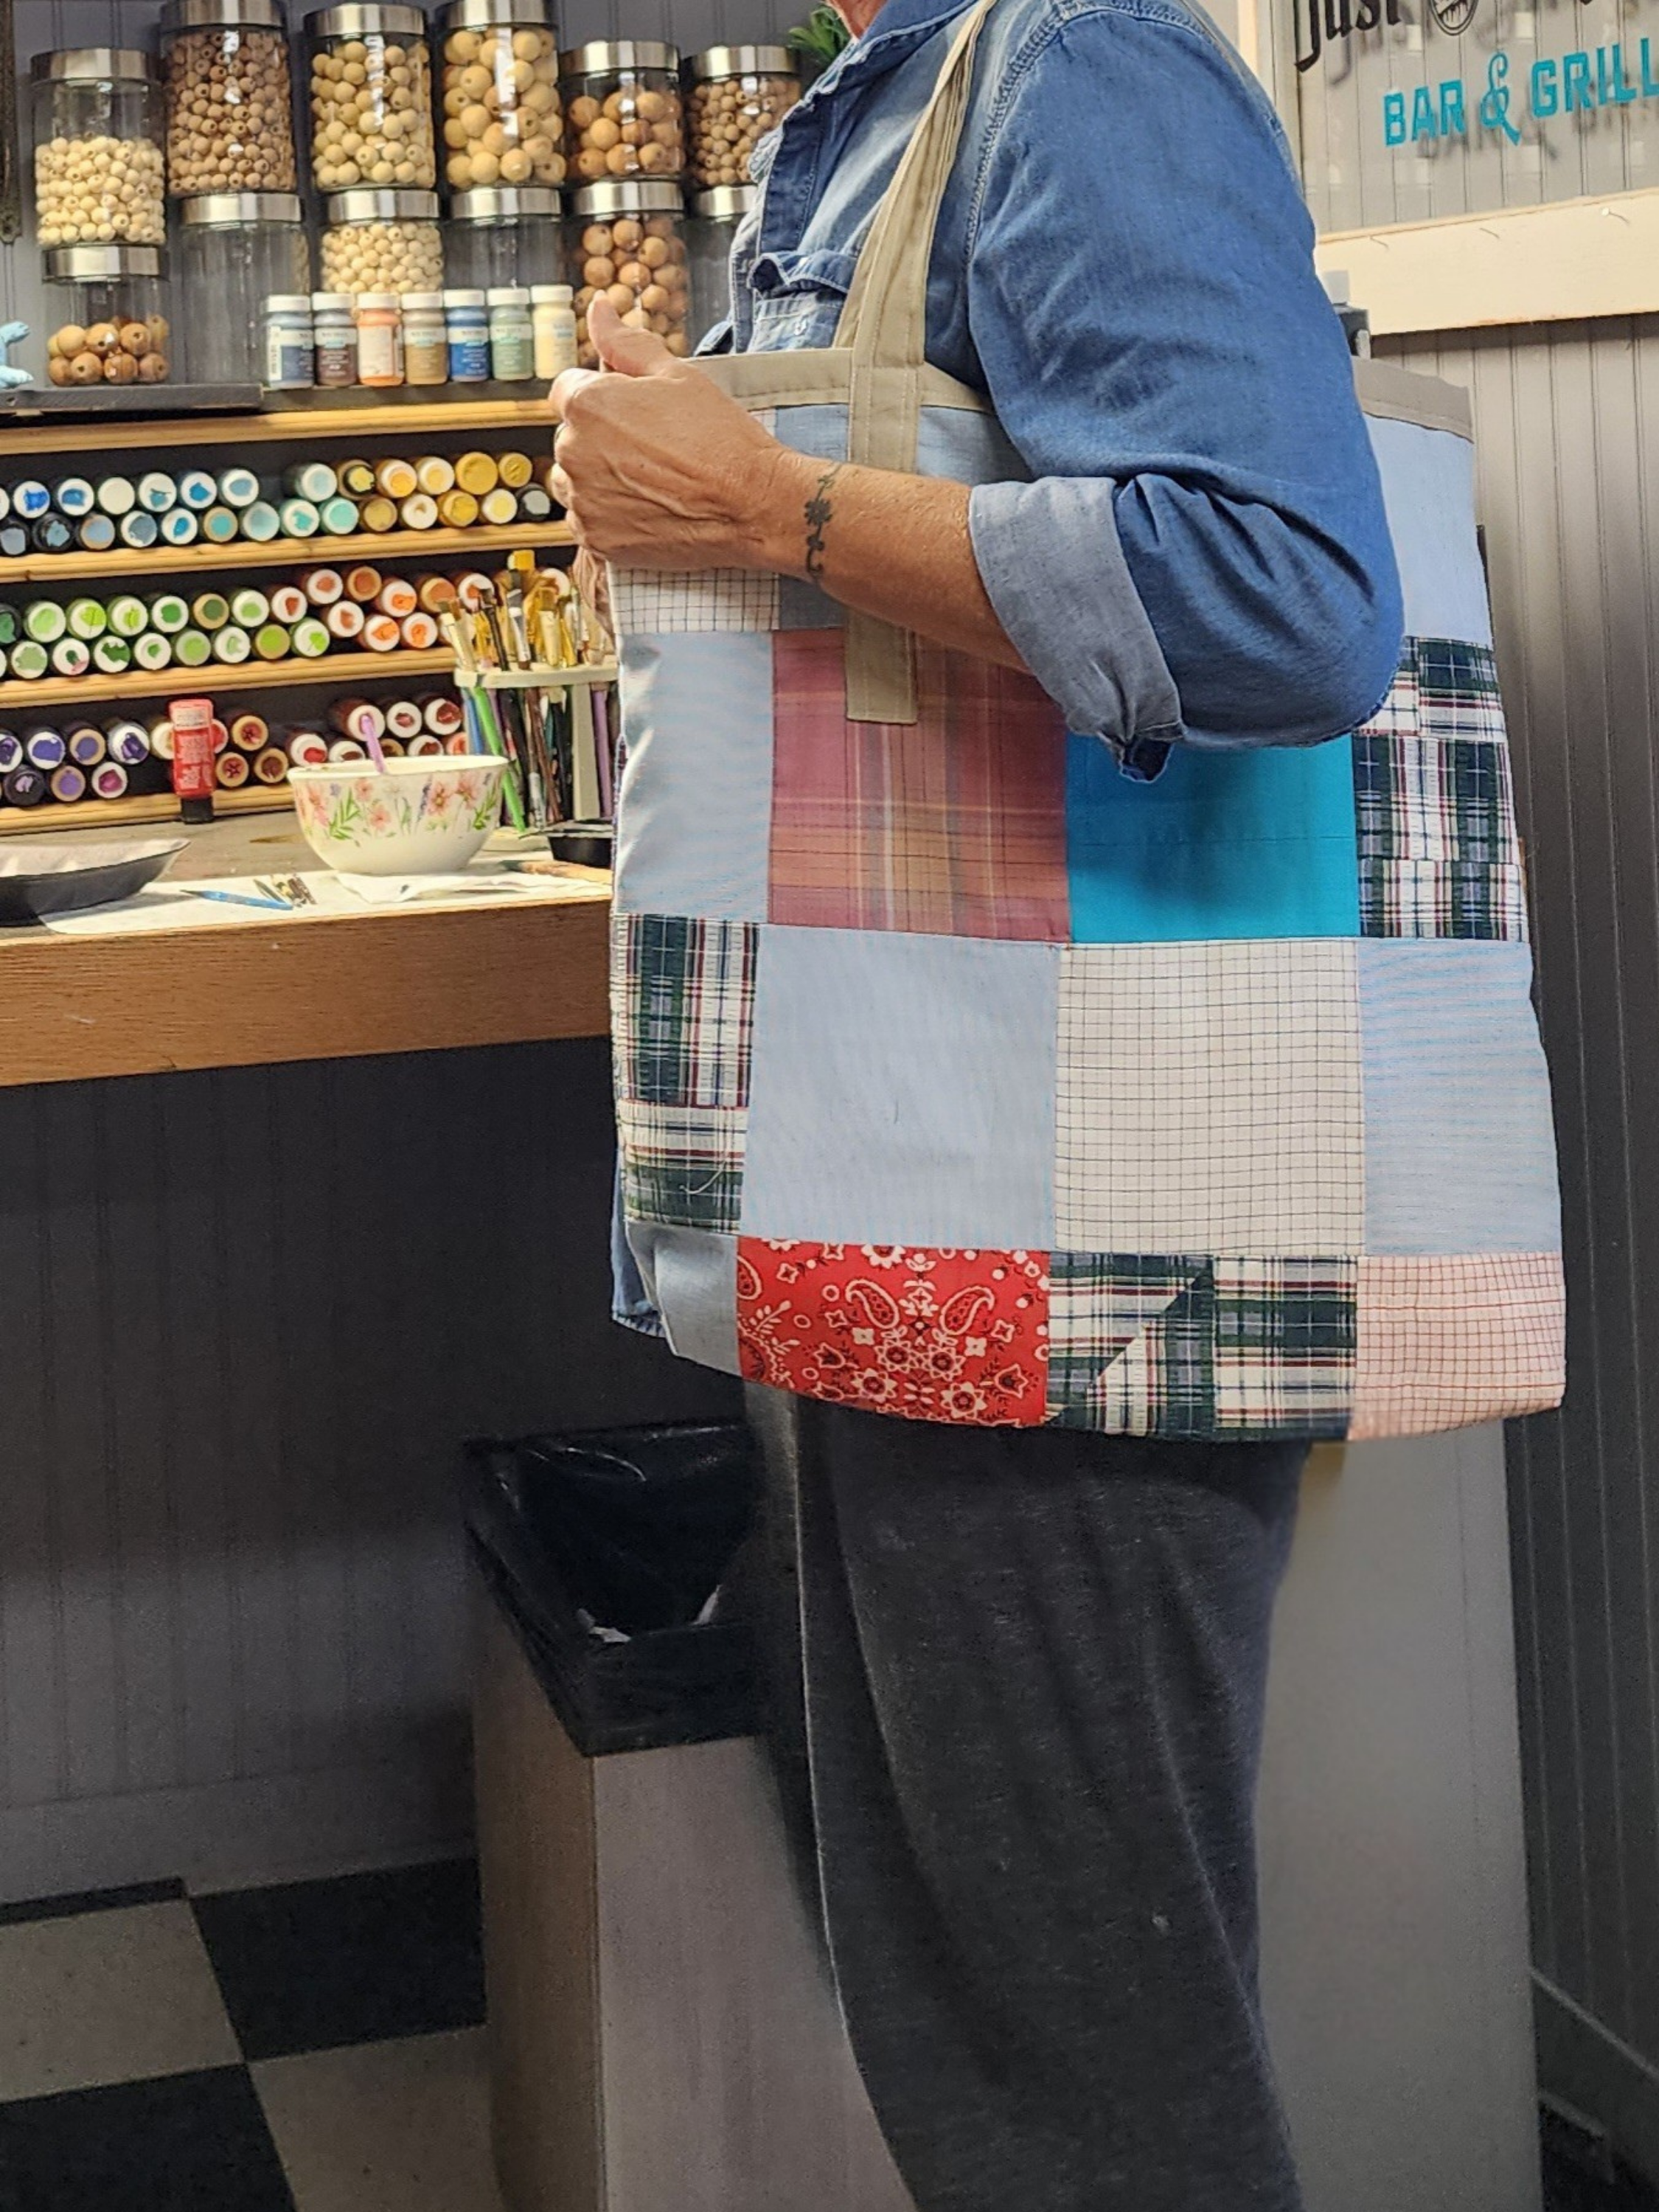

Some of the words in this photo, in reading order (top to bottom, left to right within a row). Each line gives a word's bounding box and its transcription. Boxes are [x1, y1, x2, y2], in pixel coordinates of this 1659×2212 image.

[1383, 80, 1465, 147] BAR
[1480, 52, 1521, 146] &
[1531, 38, 1659, 117] GRILL
